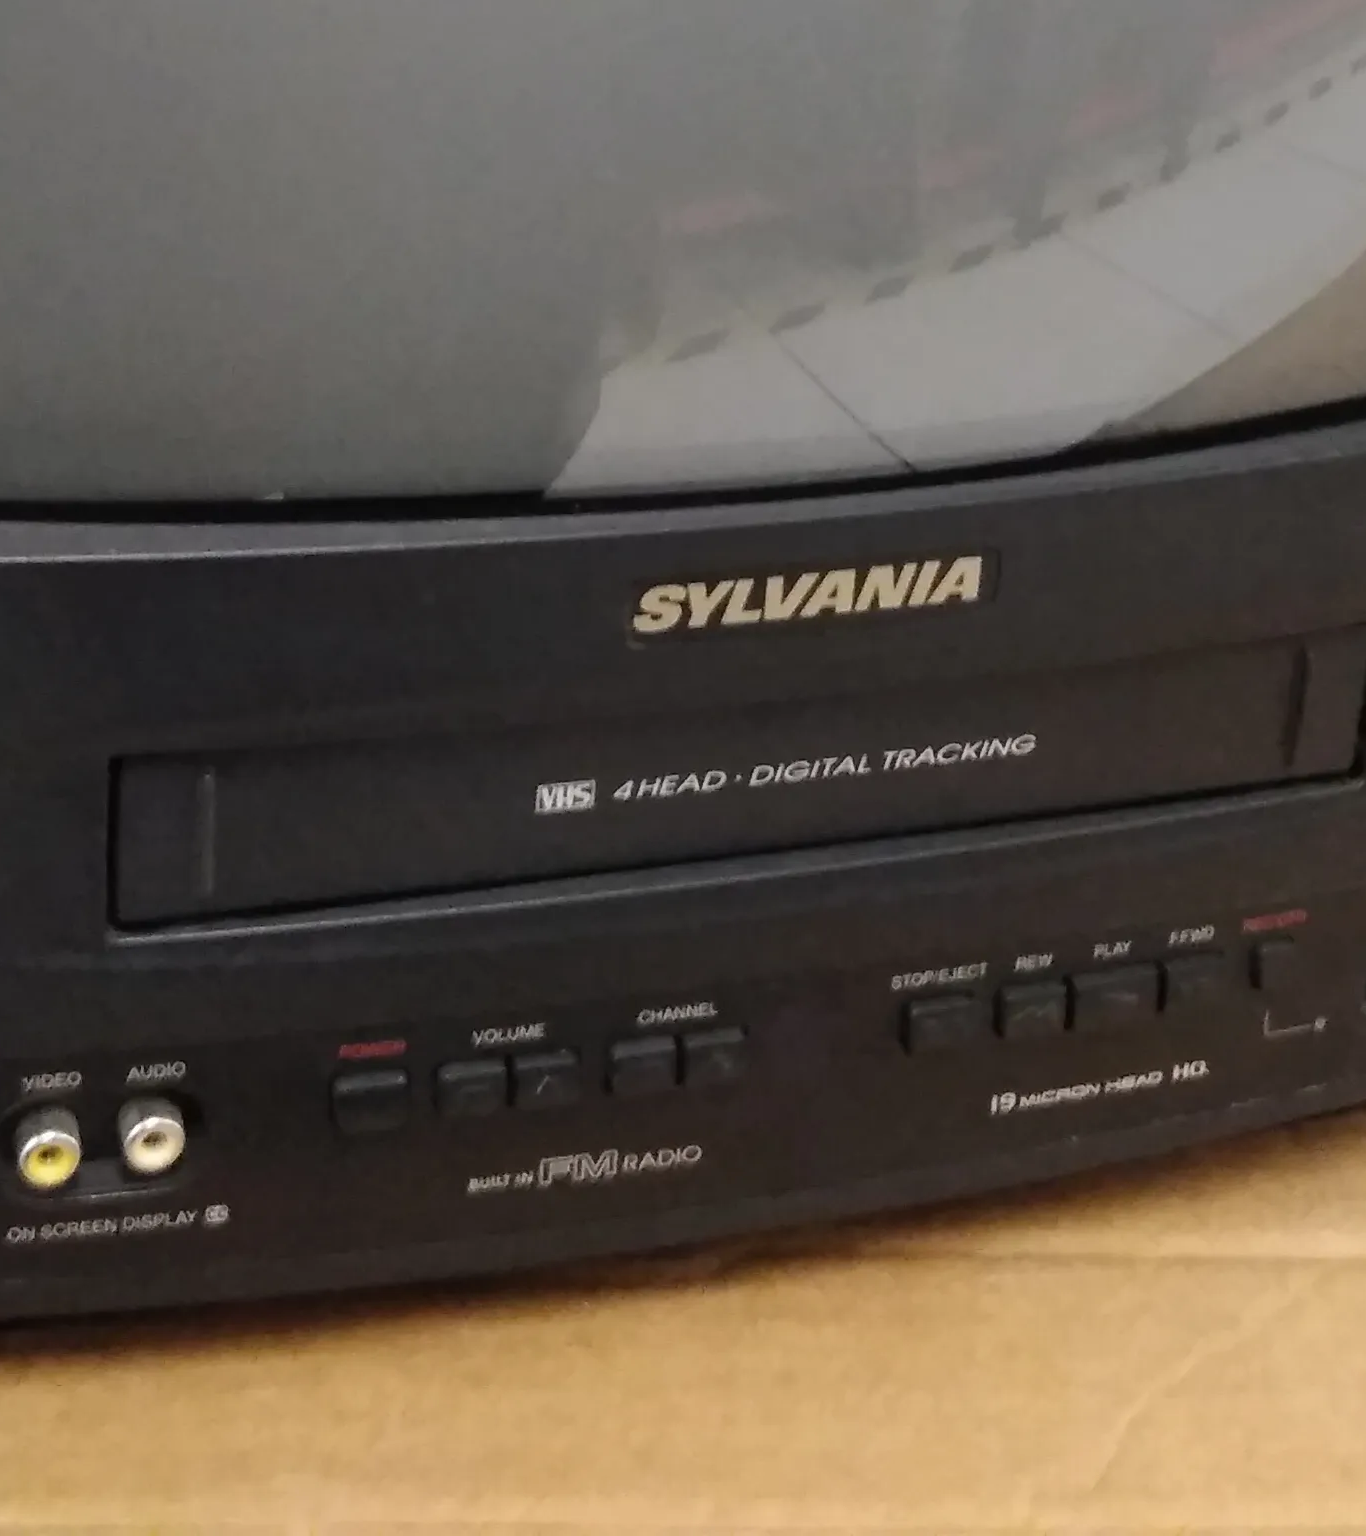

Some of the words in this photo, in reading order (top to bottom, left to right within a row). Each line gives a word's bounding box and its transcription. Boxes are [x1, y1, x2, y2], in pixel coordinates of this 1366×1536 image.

[633, 556, 982, 634] SYLVANIA
[538, 780, 594, 811] VHS
[748, 753, 870, 788] DIGITAL
[882, 733, 1037, 771] TRACKING
[1094, 940, 1132, 960] PLAY
[636, 1002, 718, 1025] CHANNEL
[471, 1022, 546, 1048] VOLUME
[22, 1070, 82, 1092] VIDEO
[126, 1061, 186, 1083] AUDIO
[538, 1149, 619, 1187] FM
[623, 1145, 703, 1172] RADIO
[6, 1226, 35, 1243] ON
[40, 1218, 117, 1238] SCREEN
[123, 1210, 198, 1232] DISPLAY
